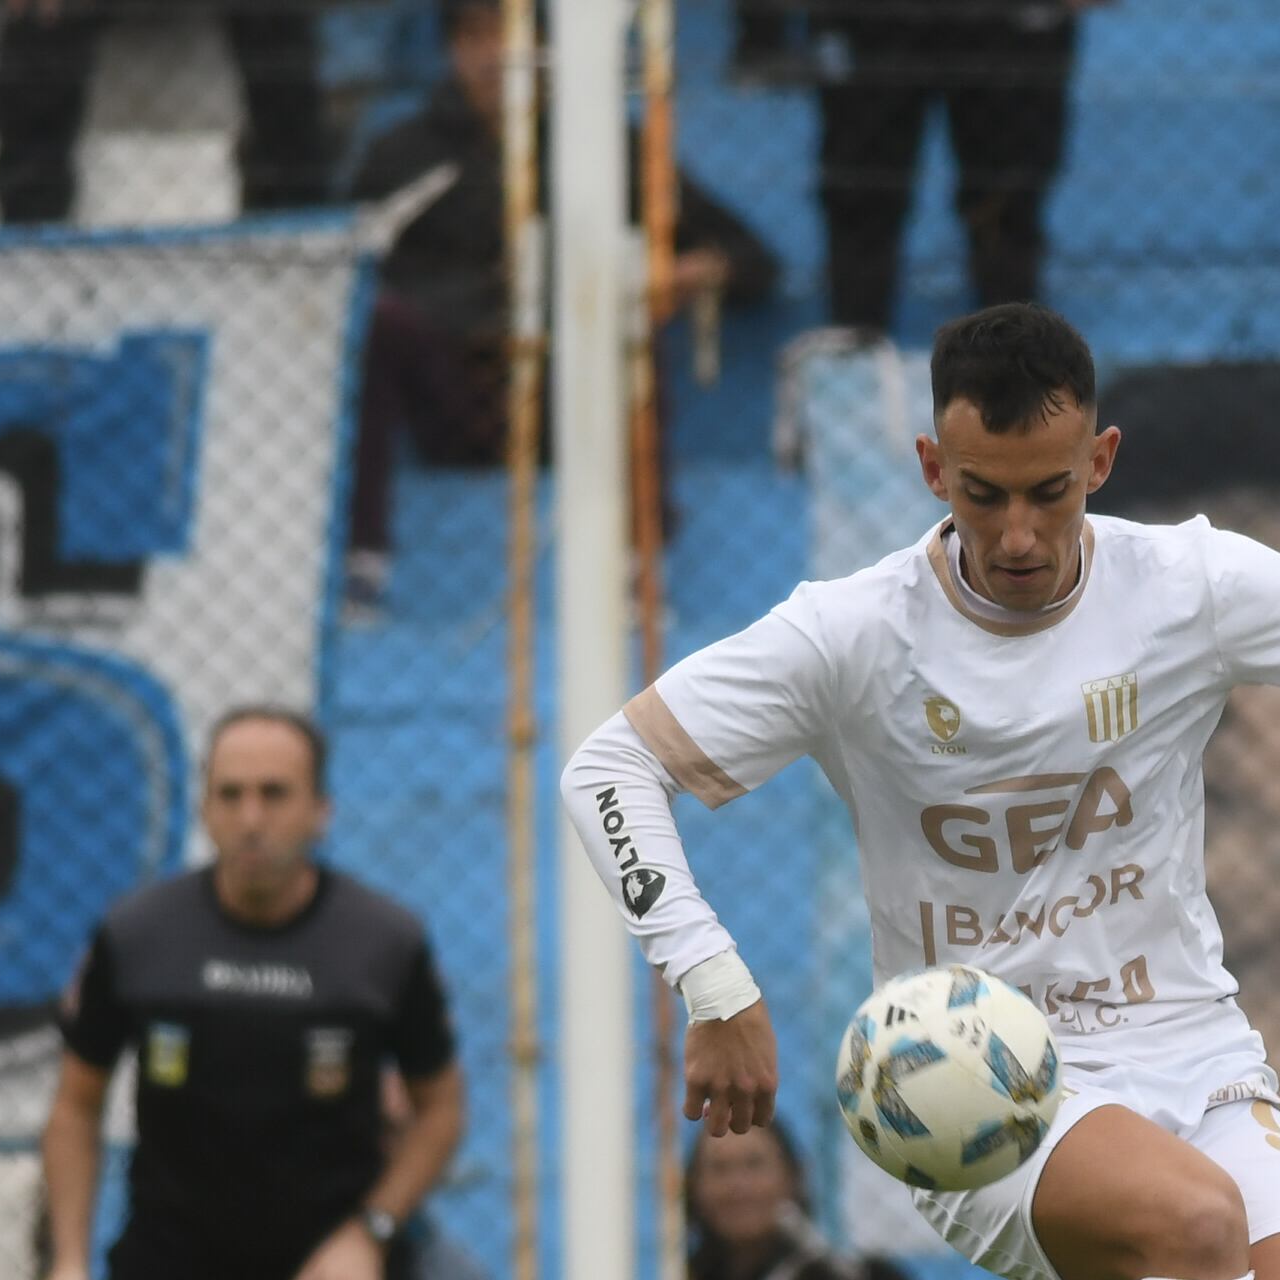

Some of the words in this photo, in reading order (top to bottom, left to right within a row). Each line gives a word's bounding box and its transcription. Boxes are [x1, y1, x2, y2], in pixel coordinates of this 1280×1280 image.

[931, 744, 967, 755] LYON
[596, 786, 640, 872] LYON
[921, 767, 1134, 874] GEA
[946, 863, 1145, 948] BANCOR
